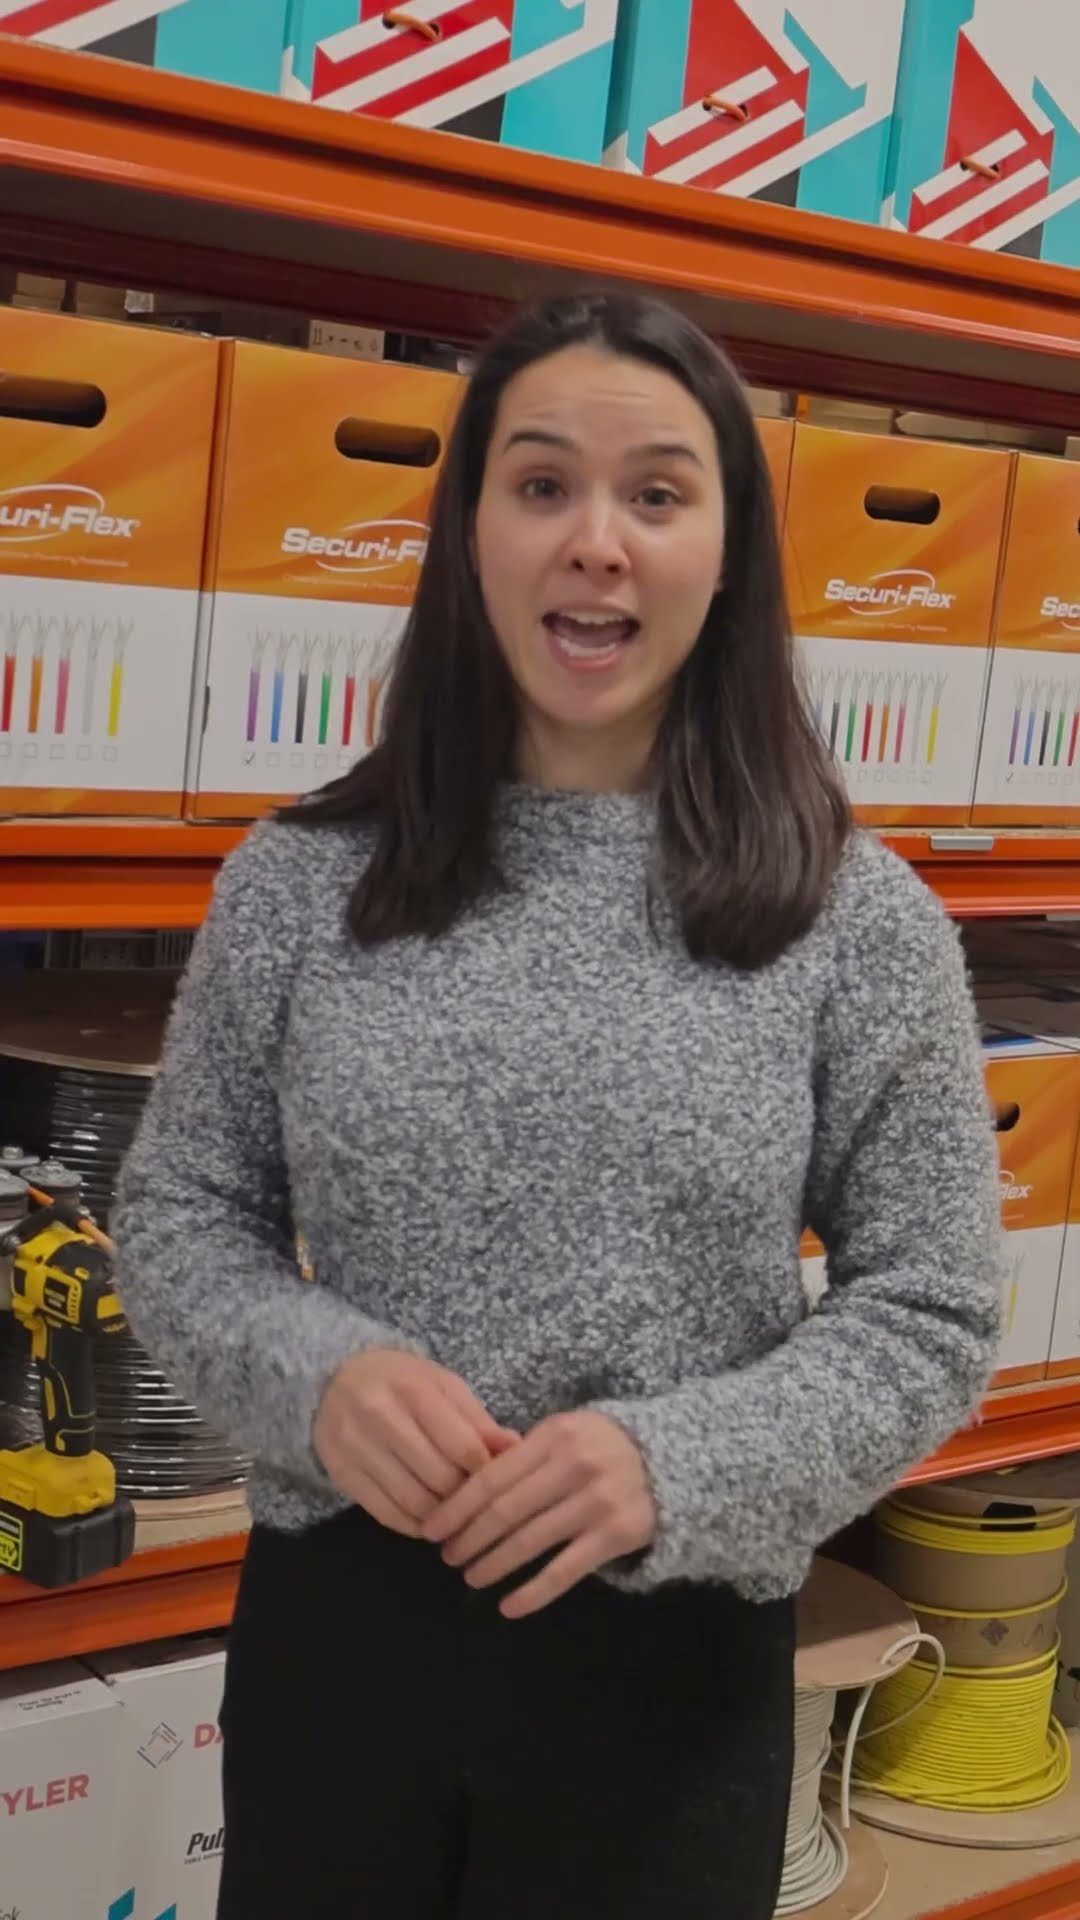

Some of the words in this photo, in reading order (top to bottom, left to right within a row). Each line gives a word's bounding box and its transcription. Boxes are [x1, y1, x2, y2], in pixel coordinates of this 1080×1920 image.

[824, 578, 952, 609] Securi-Flex
[193, 1722, 223, 1749] D
[2, 1773, 90, 1816] YLER
[186, 1827, 224, 1856] Pul
